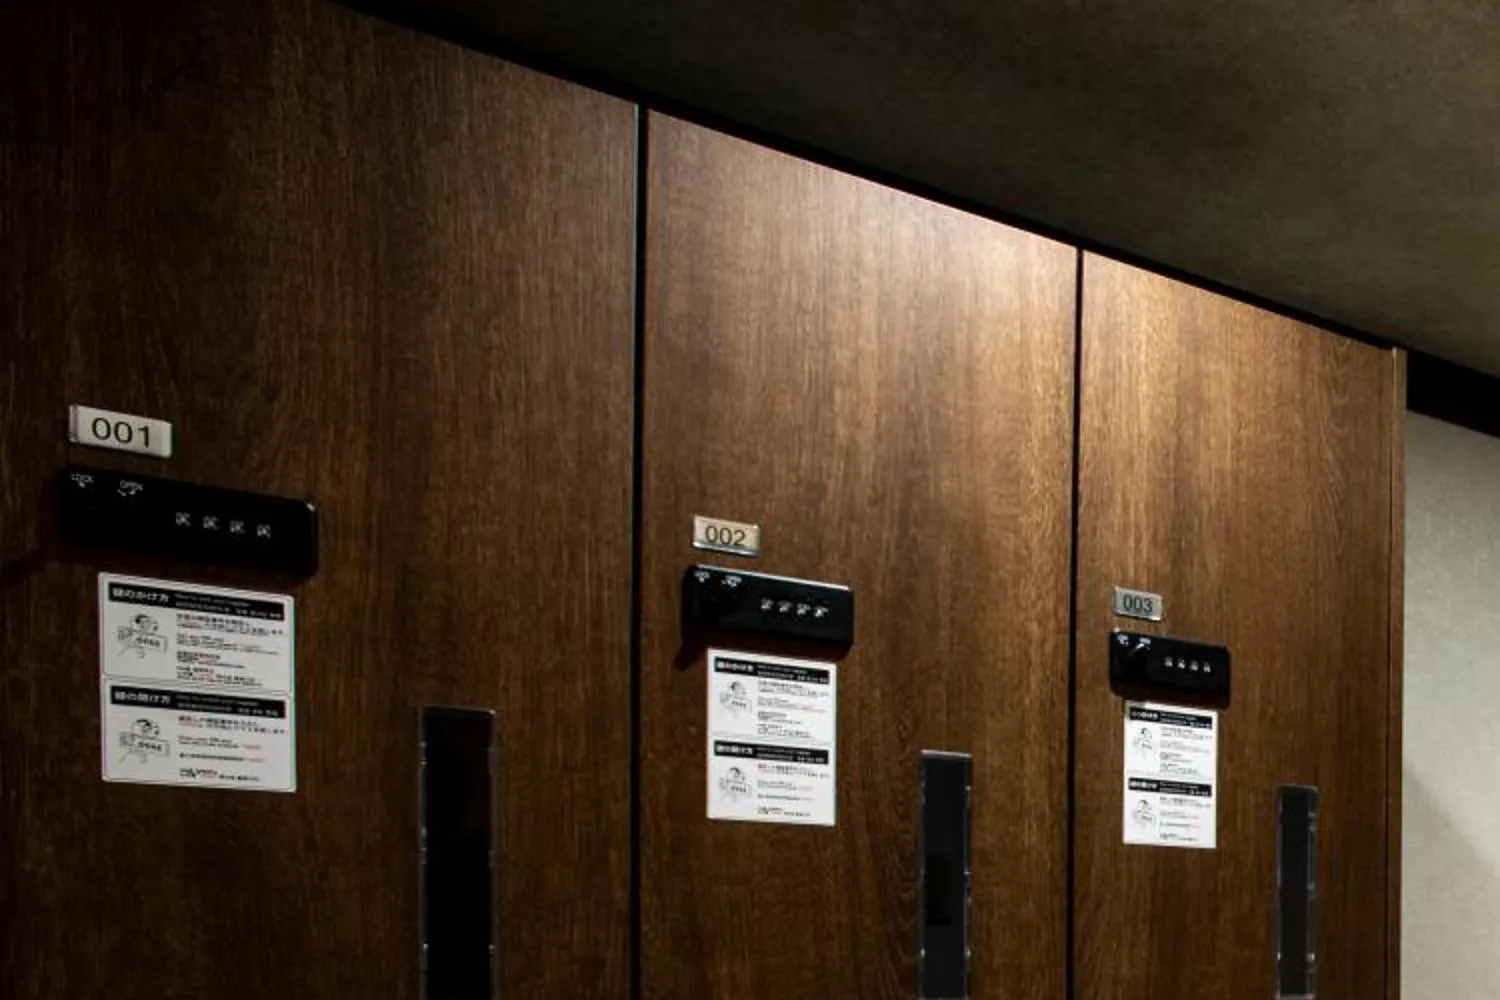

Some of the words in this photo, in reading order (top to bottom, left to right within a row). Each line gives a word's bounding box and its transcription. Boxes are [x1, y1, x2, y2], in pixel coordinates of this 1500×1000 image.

[92, 417, 150, 448] 001
[705, 524, 746, 547] 002
[1123, 593, 1153, 615] 003
